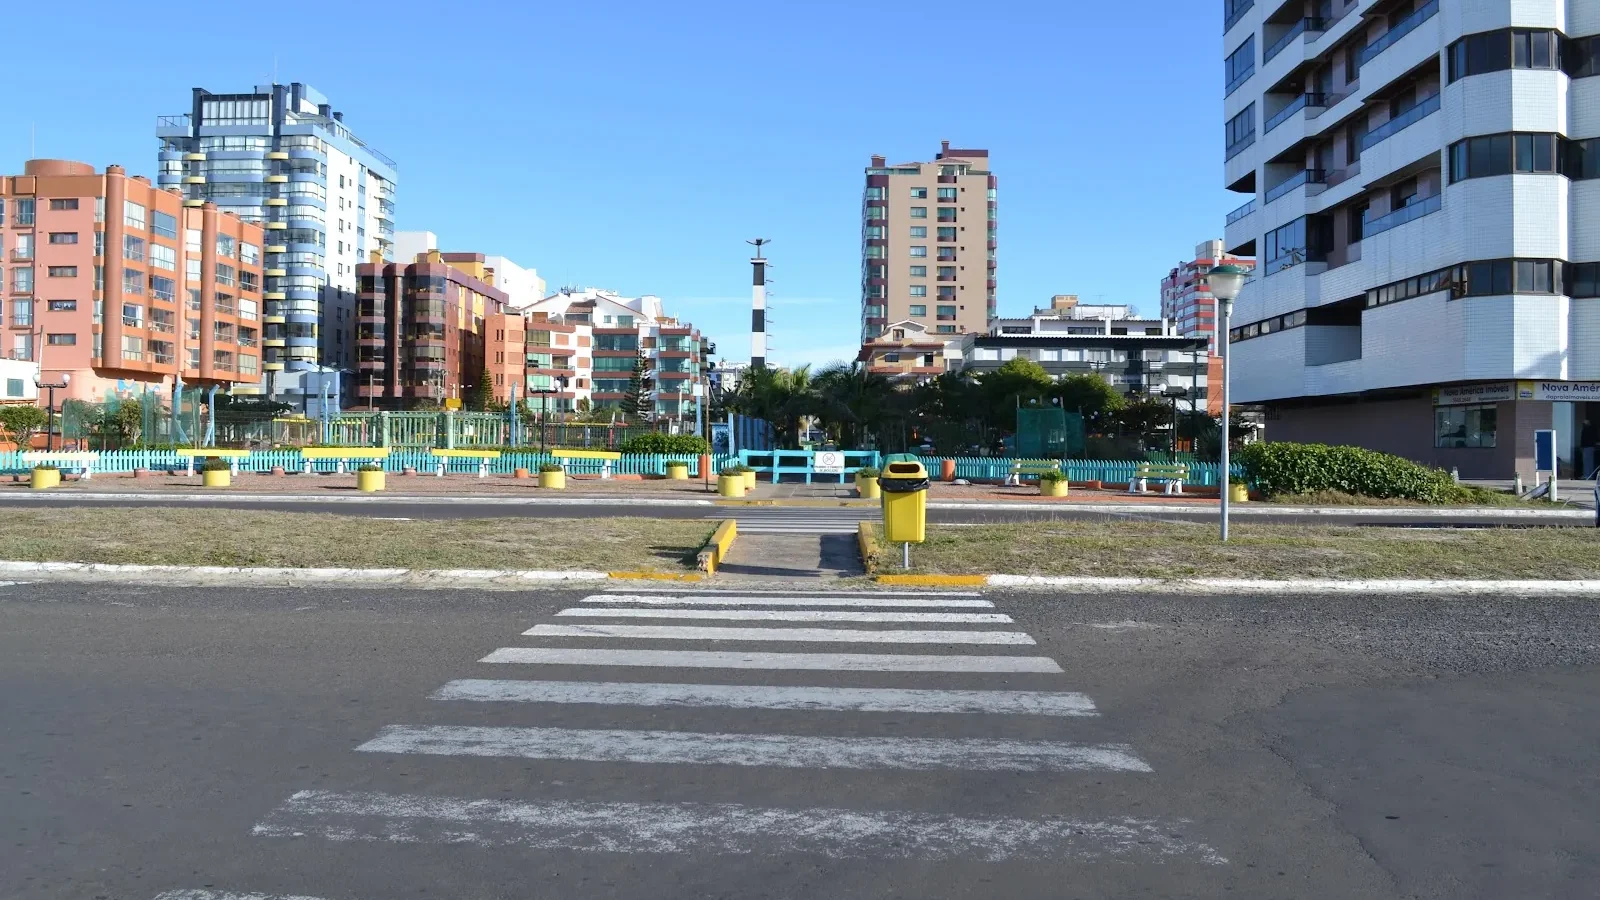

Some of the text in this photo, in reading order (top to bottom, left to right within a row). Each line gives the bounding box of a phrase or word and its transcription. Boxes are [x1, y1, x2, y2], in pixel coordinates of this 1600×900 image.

[1444, 388, 1458, 397] Nova
[1460, 385, 1484, 396] América
[1542, 383, 1569, 392] Nova
